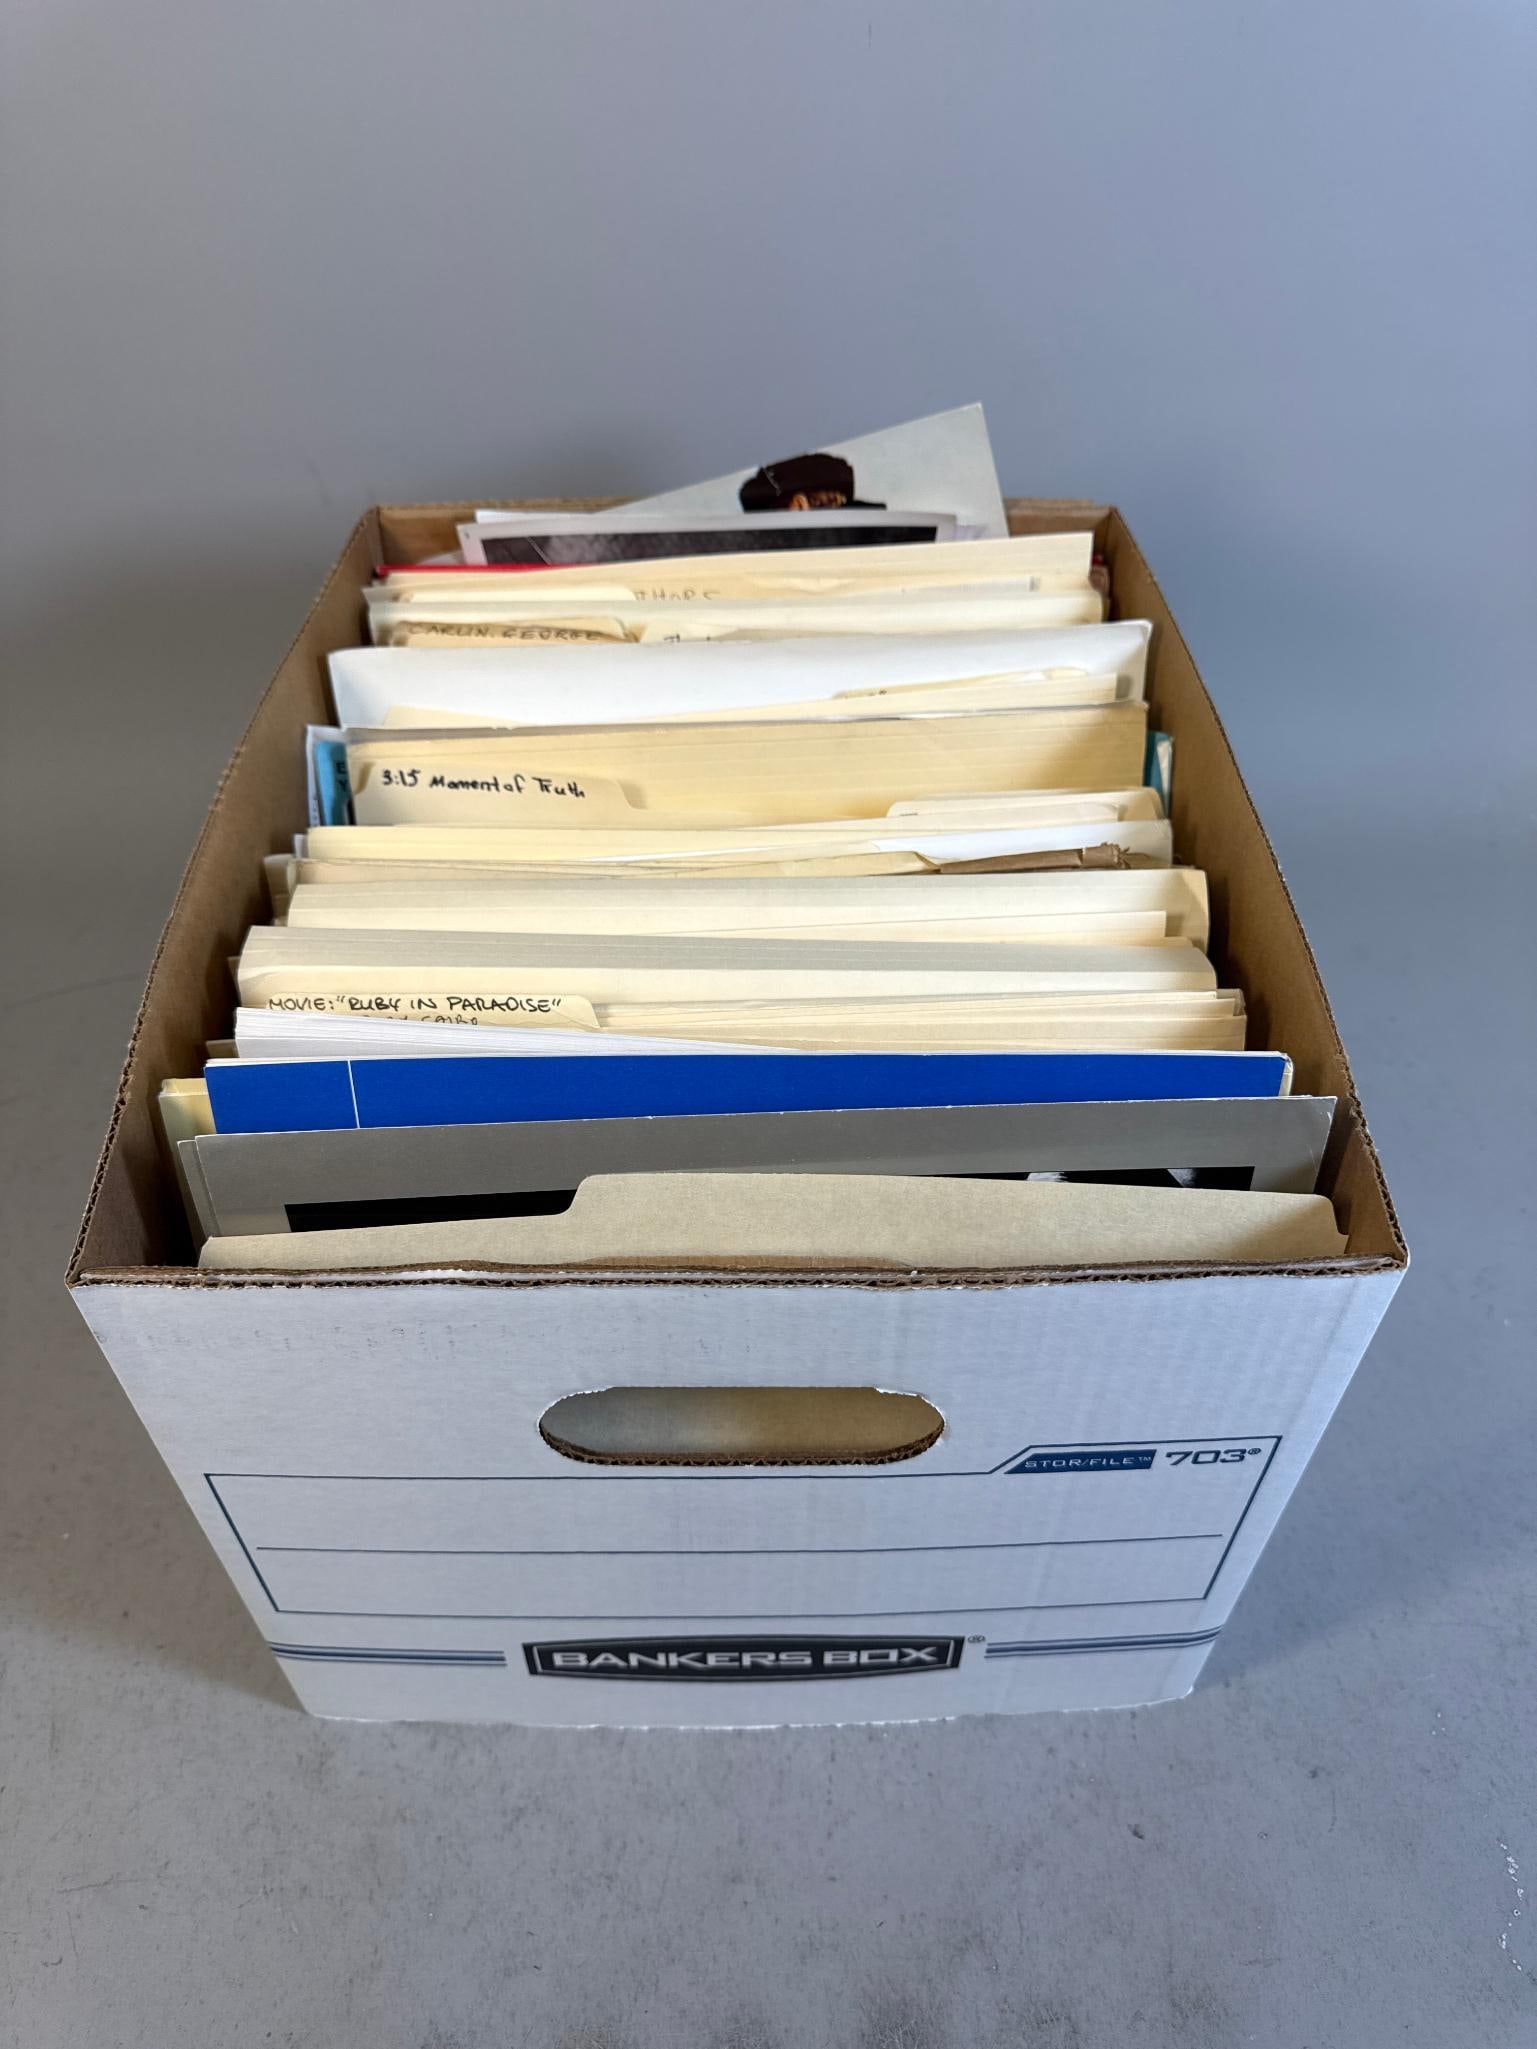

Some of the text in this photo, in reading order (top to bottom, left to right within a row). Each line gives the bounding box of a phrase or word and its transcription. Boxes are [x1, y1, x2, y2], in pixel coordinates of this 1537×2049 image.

[382, 768, 420, 788] 3:15
[429, 775, 500, 792] Moment
[531, 776, 586, 799] Truth
[268, 996, 335, 1011] MOVIE:
[410, 997, 438, 1009] IN
[552, 1650, 812, 1668] BANKERS
